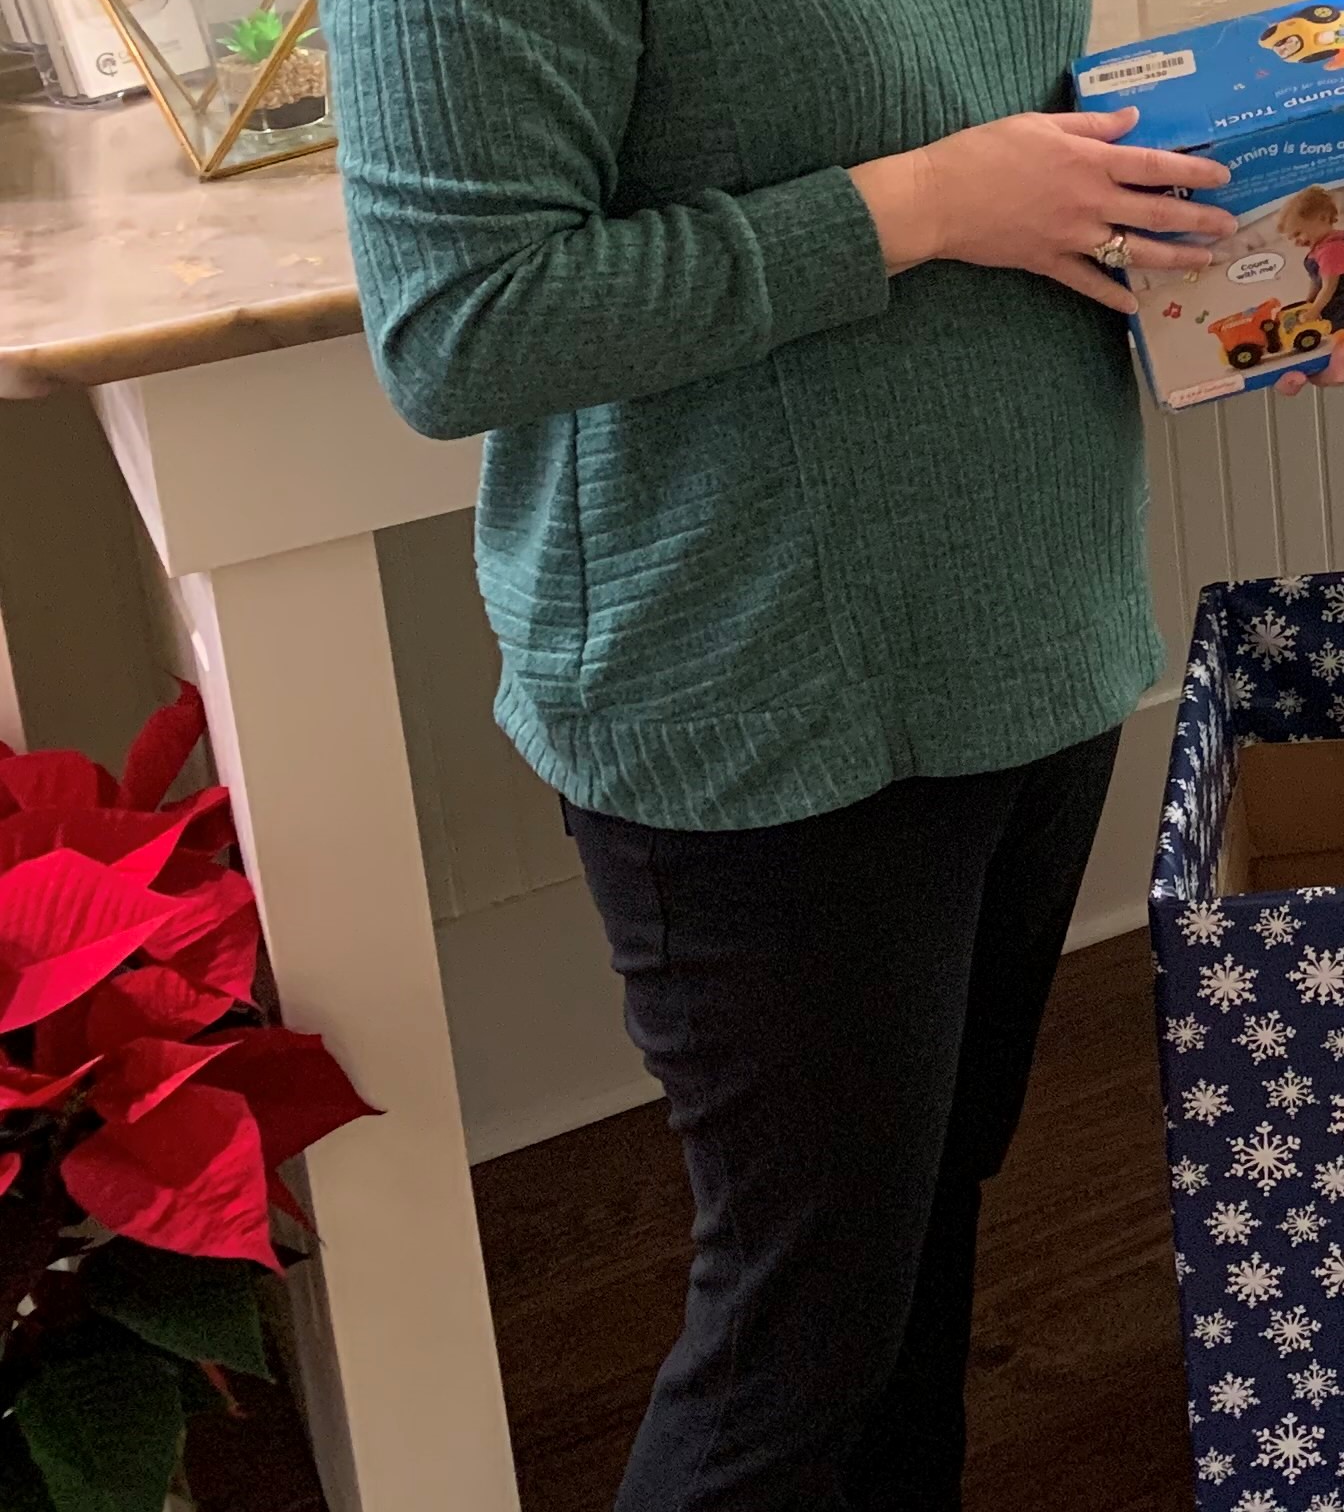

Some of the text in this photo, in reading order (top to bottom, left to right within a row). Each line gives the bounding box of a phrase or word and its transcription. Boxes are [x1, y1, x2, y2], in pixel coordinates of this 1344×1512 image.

[1214, 105, 1277, 128] Truck
[1228, 142, 1278, 170] arning
[1283, 141, 1294, 154] is
[1300, 142, 1333, 155] tons
[1236, 264, 1278, 280] with me!
[1240, 258, 1270, 272] Count
